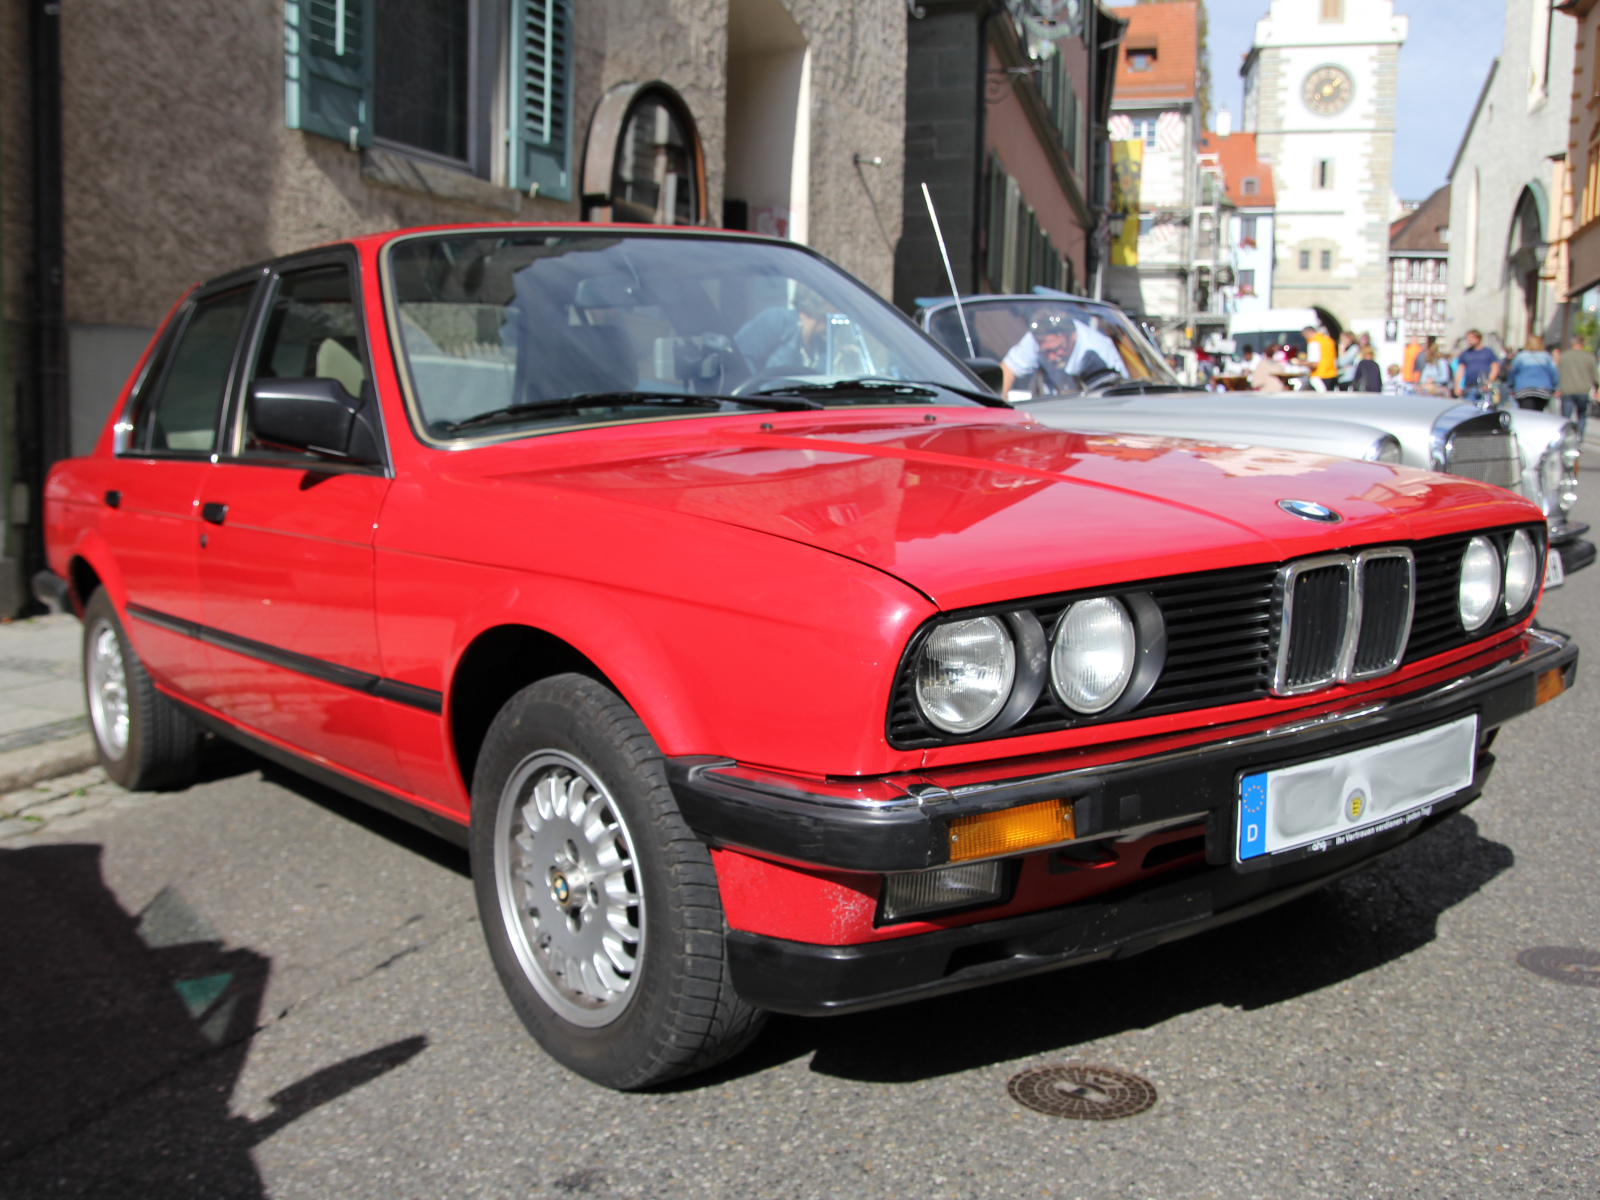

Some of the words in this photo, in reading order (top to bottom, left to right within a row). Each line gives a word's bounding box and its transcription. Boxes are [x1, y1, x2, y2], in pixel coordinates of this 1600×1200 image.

[1247, 823, 1259, 843] D
[1335, 836, 1345, 846] Ihr
[1345, 826, 1376, 843] Vertrauen
